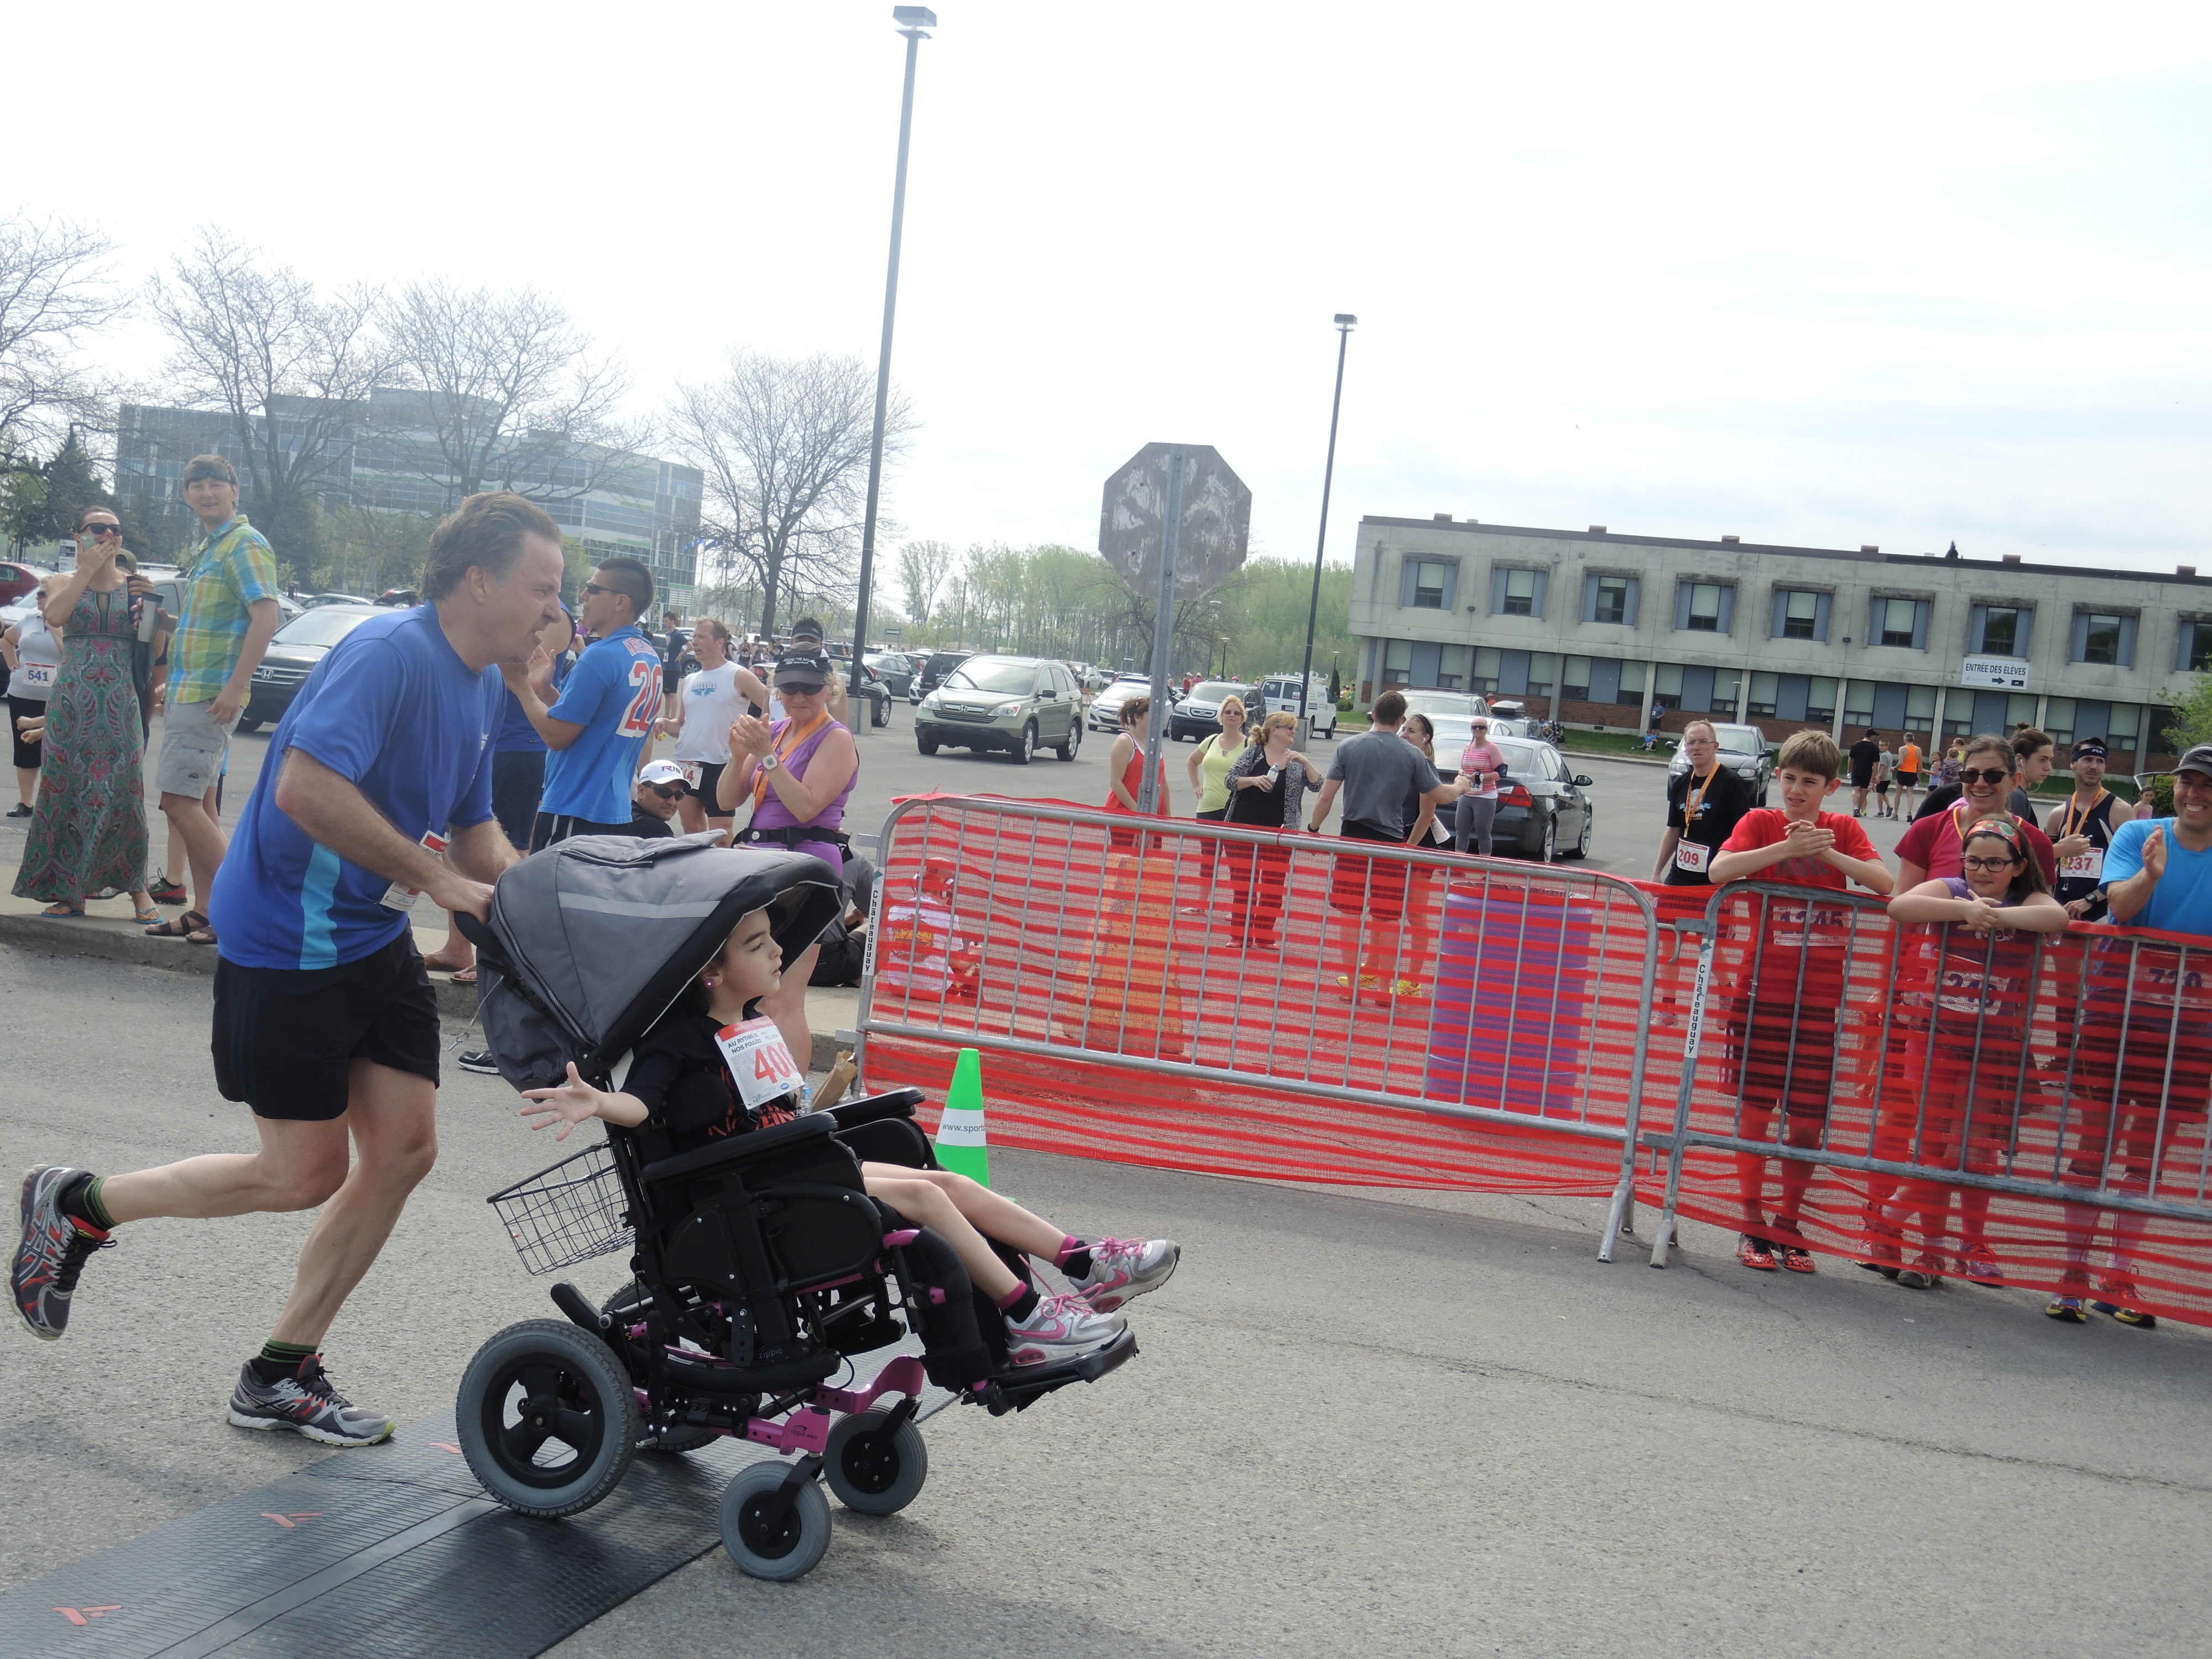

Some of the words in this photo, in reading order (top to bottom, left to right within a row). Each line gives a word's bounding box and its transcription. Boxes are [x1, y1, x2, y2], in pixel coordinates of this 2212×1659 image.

[28, 670, 49, 682] 541
[1965, 662, 1989, 672] ENTRÉE
[1990, 665, 2002, 674] DES
[2004, 664, 2026, 676] ÉLÈVES
[615, 660, 664, 738] 20
[1678, 849, 1699, 866] 209
[2065, 857, 2093, 871] 237
[865, 890, 878, 972] Châteauguay
[728, 1041, 737, 1049] AU
[738, 1034, 753, 1044] RYTHME
[732, 1045, 744, 1054] NOS
[758, 1348, 783, 1359] zippie
